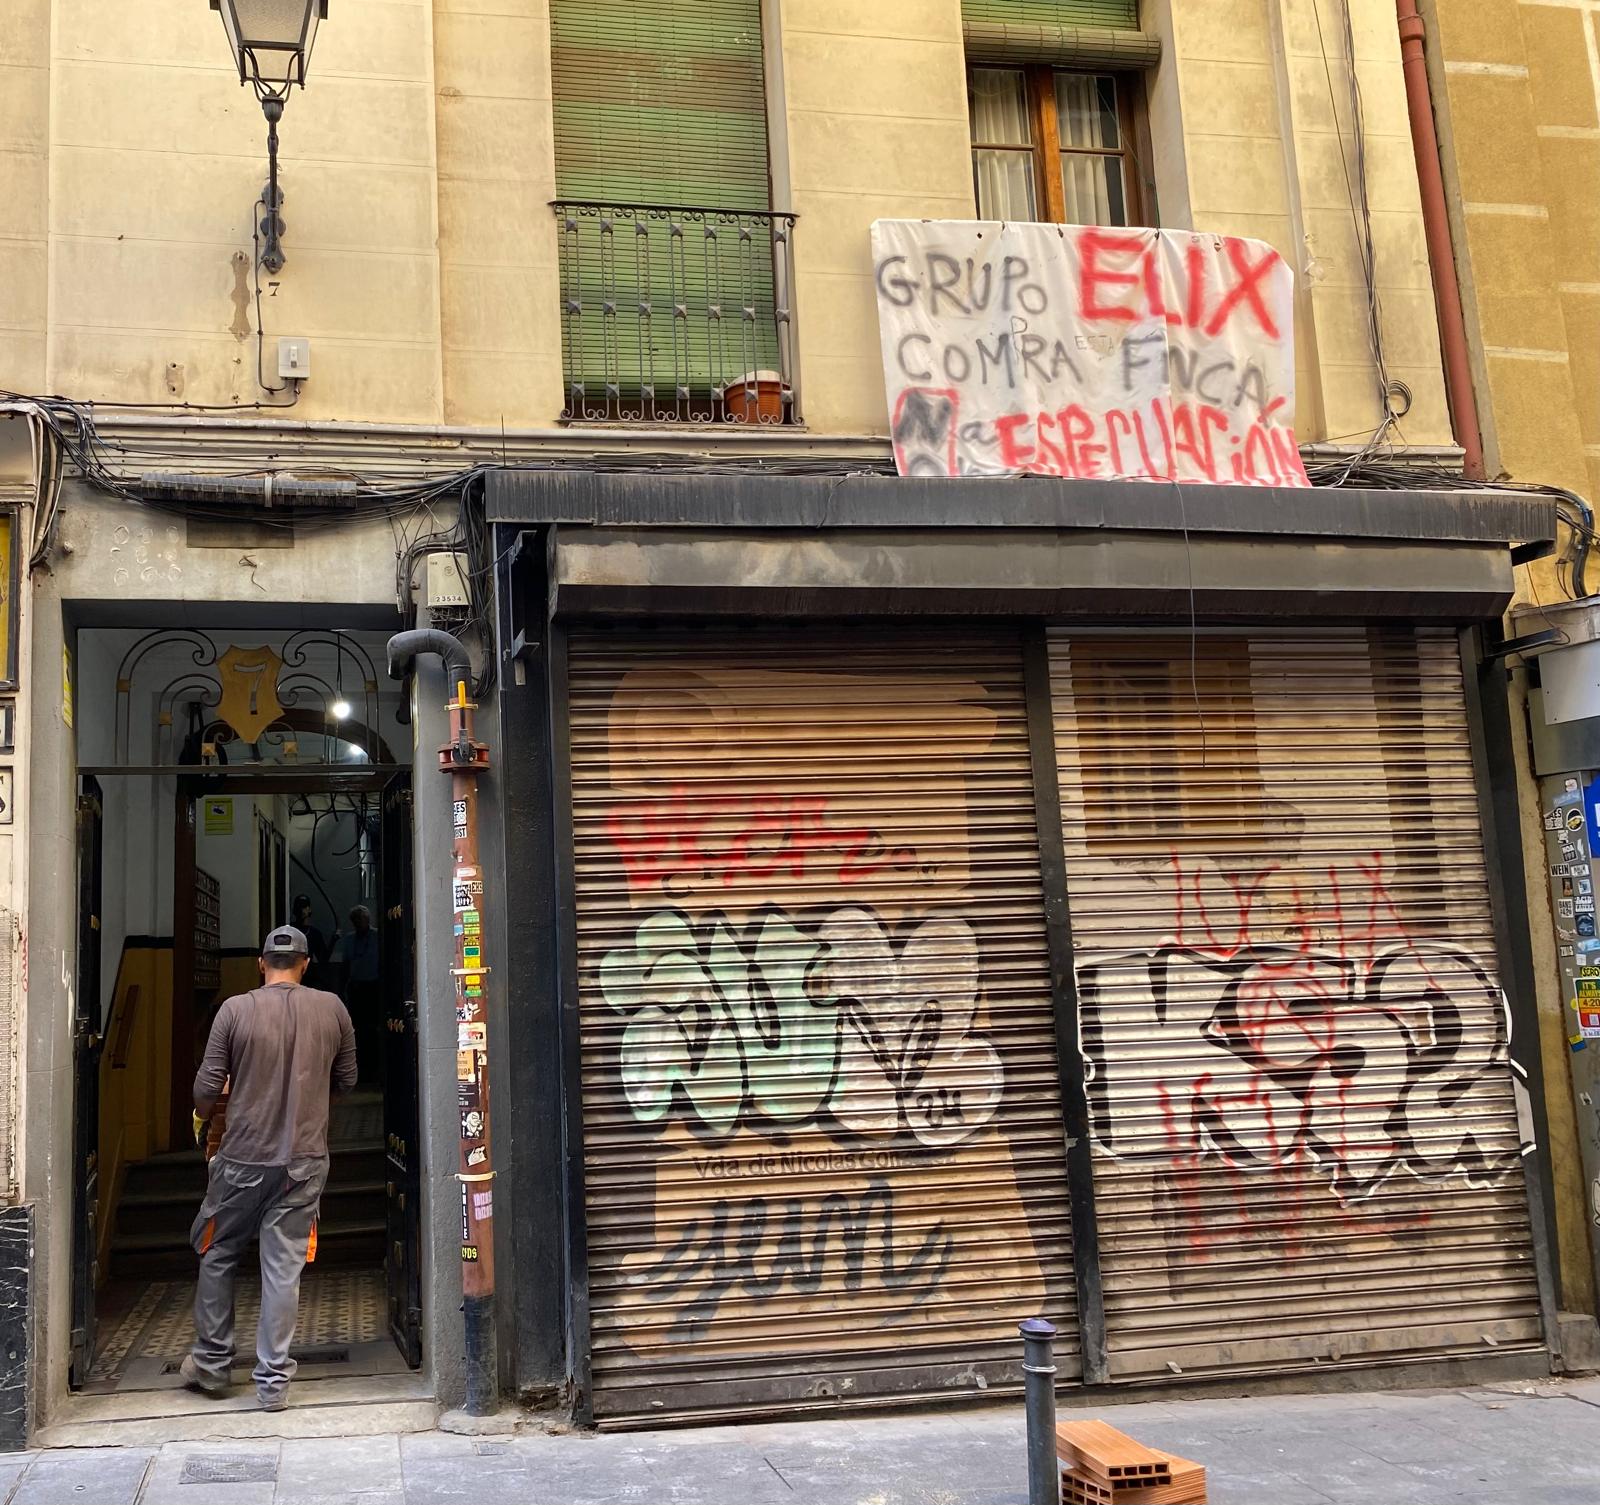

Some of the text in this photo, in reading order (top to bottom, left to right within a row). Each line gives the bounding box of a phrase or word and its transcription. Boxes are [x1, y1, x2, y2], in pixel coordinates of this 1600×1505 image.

[876, 227, 1281, 340] GRUPO ELIX
[233, 662, 268, 715] 7
[749, 1154, 775, 1175] de
